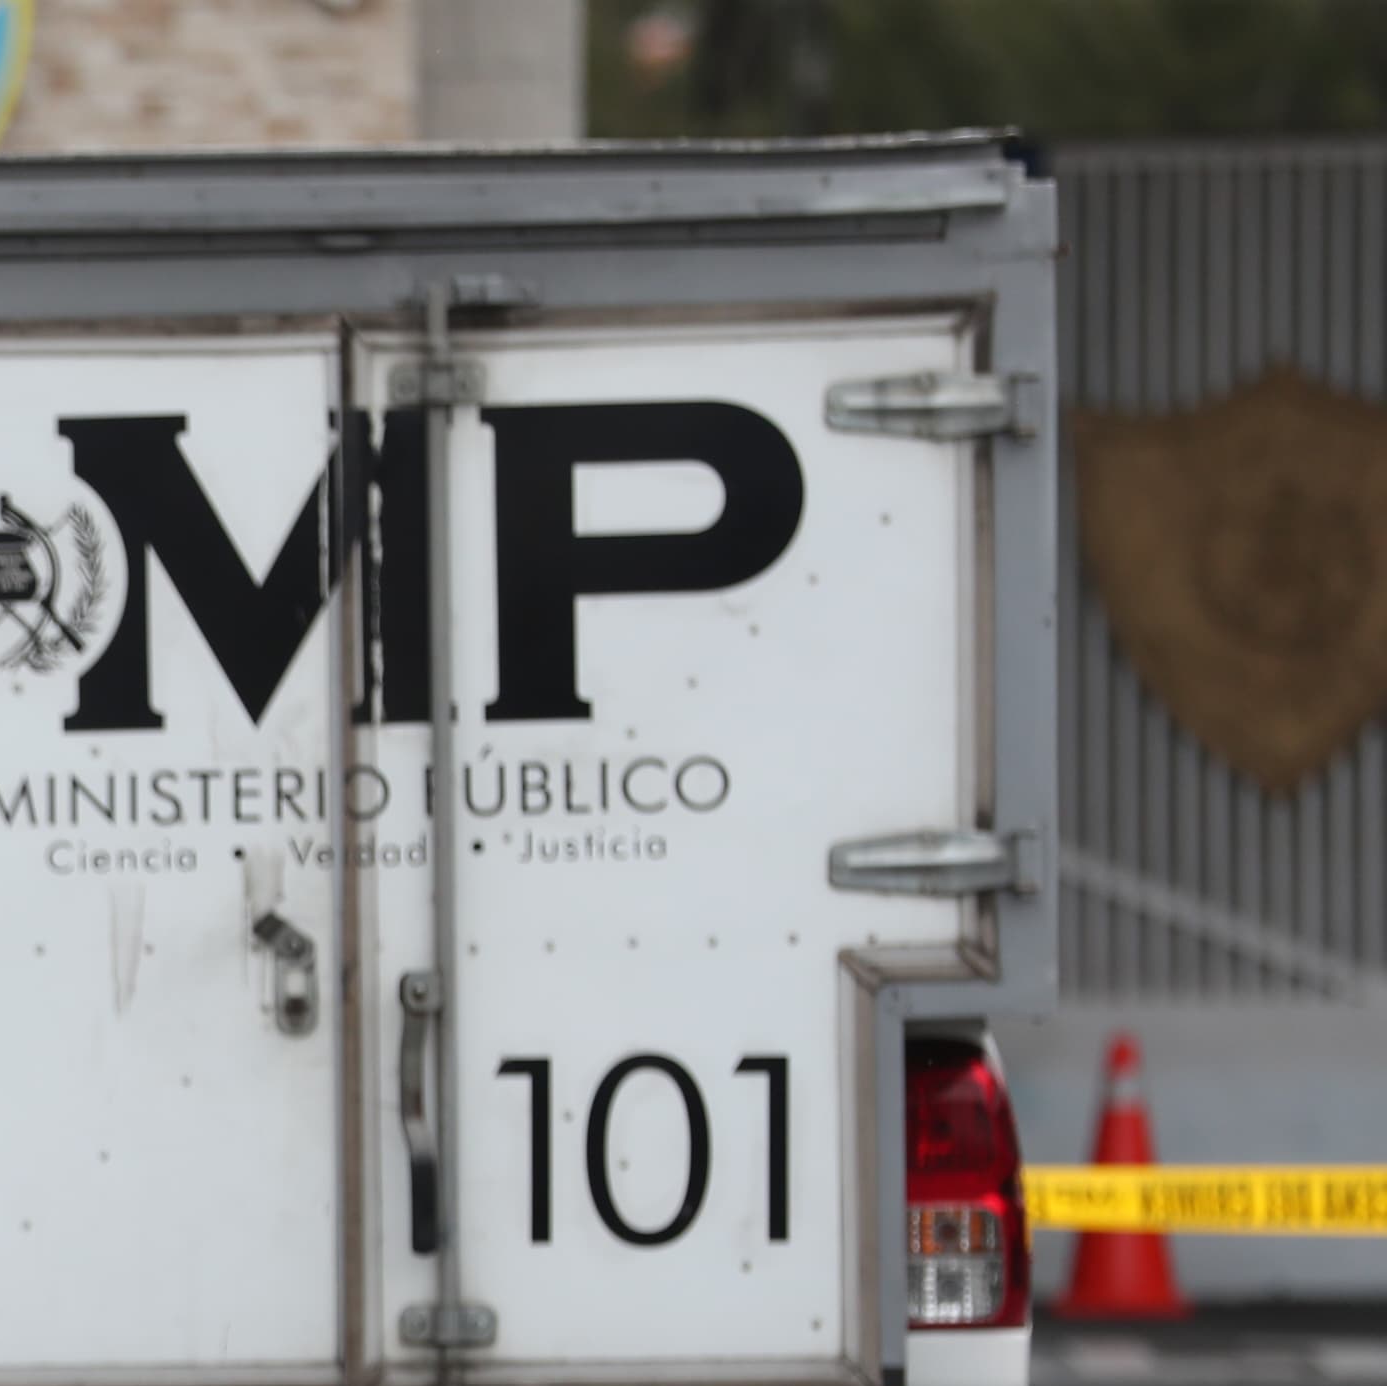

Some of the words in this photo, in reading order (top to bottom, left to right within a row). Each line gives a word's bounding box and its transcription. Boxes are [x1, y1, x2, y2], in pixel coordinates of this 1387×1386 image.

[57, 399, 805, 731] MP
[46, 838, 199, 876] Ciencia
[289, 834, 427, 869] Vedad
[517, 829, 669, 867] Justicia
[495, 1053, 790, 1246] 101
